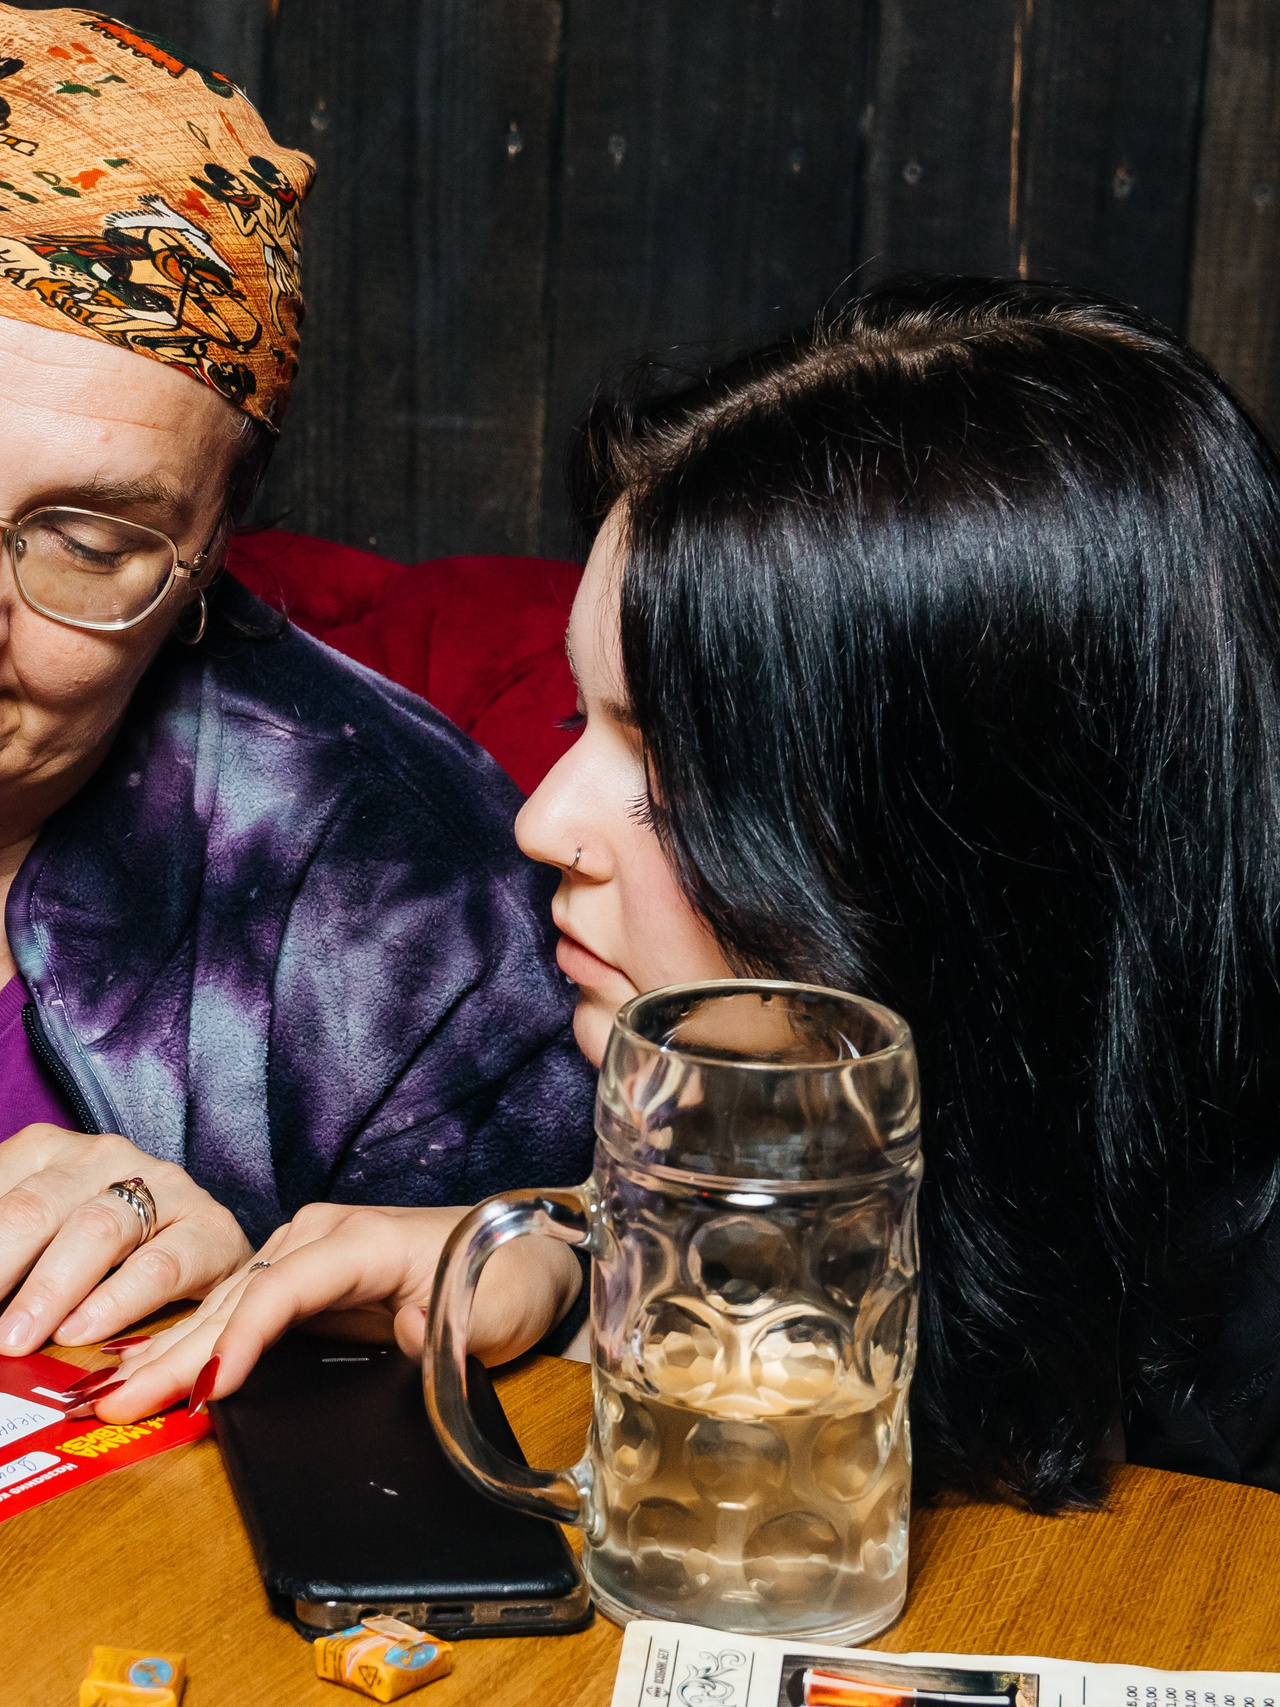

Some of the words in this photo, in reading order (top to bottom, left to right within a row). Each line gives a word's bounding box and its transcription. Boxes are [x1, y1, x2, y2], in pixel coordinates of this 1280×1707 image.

[30, 1386, 76, 1403] 1
[74, 1426, 152, 1458] МАМА
[9, 1462, 78, 1495] Название
